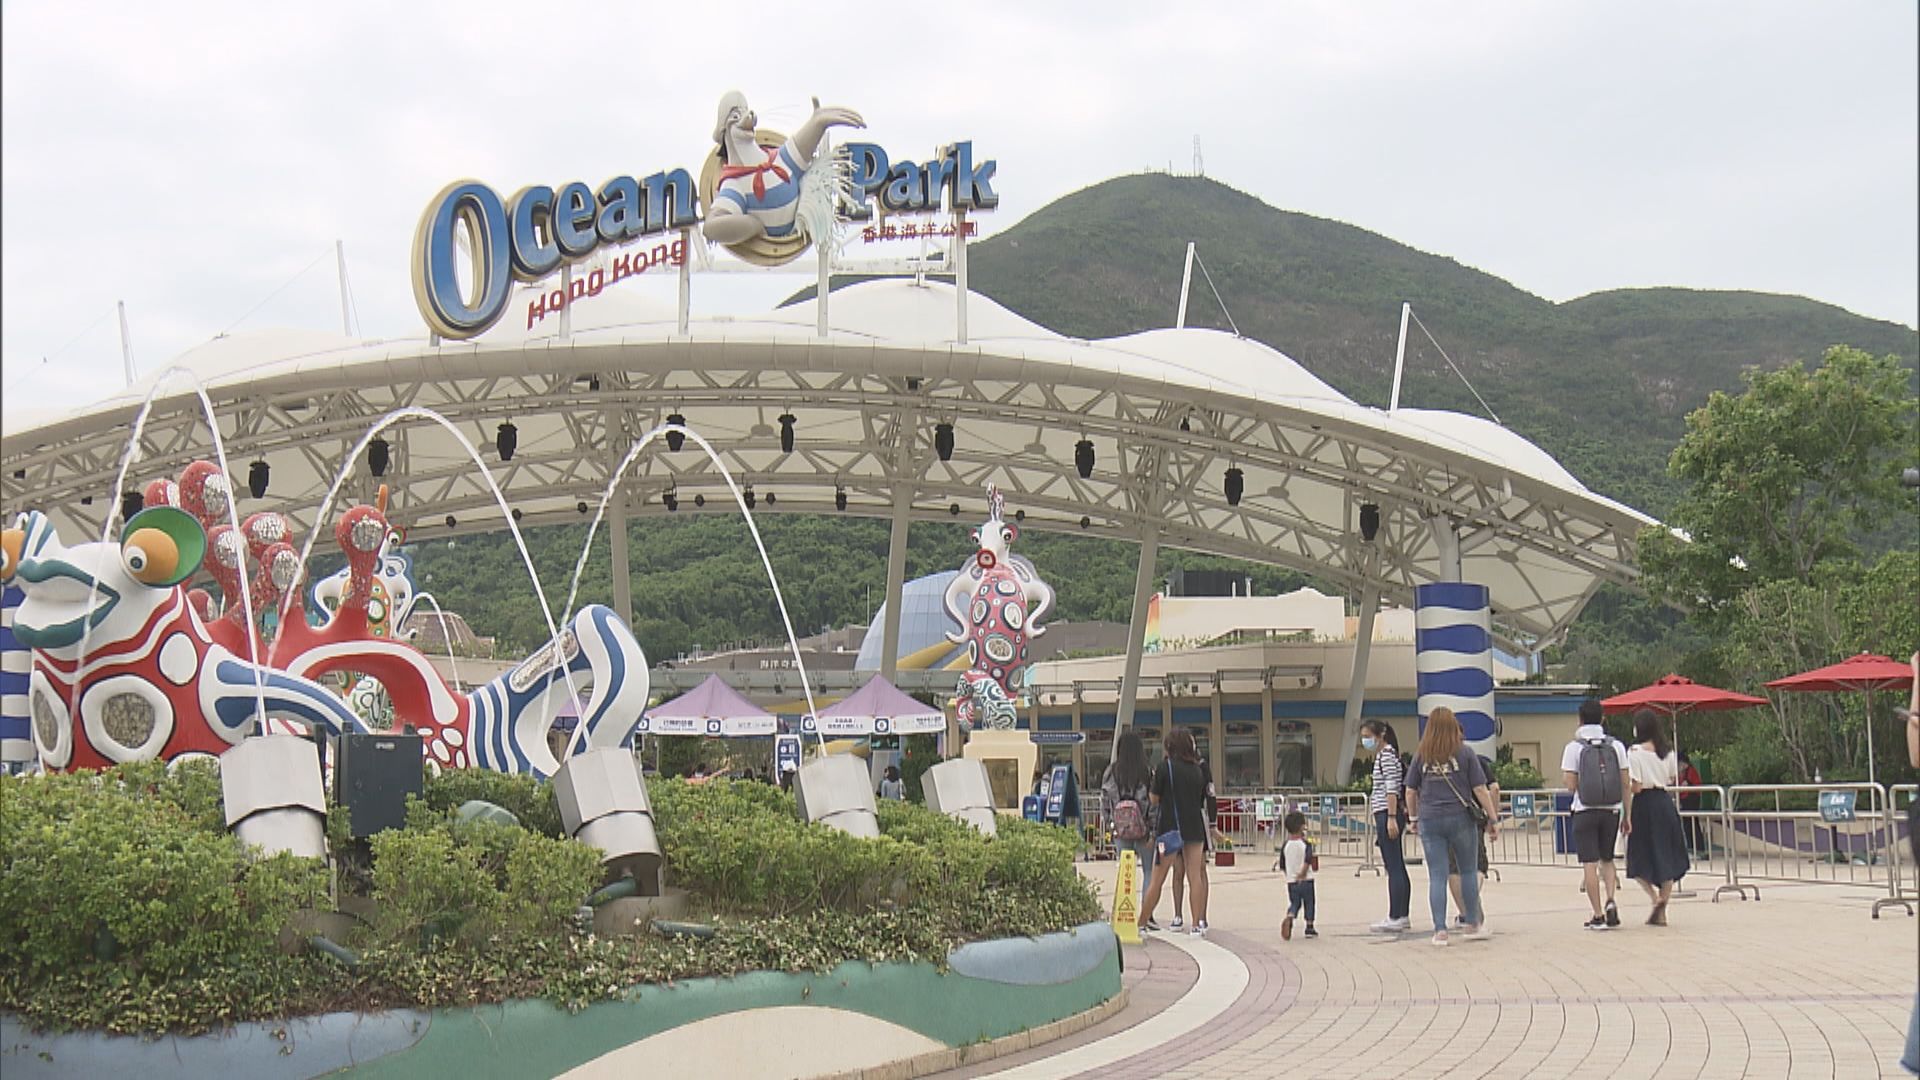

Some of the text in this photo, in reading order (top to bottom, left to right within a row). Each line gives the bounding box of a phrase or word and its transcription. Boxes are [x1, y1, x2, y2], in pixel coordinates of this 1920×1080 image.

[412, 140, 998, 339] Ocean Park
[527, 239, 687, 331] Hong Kong
